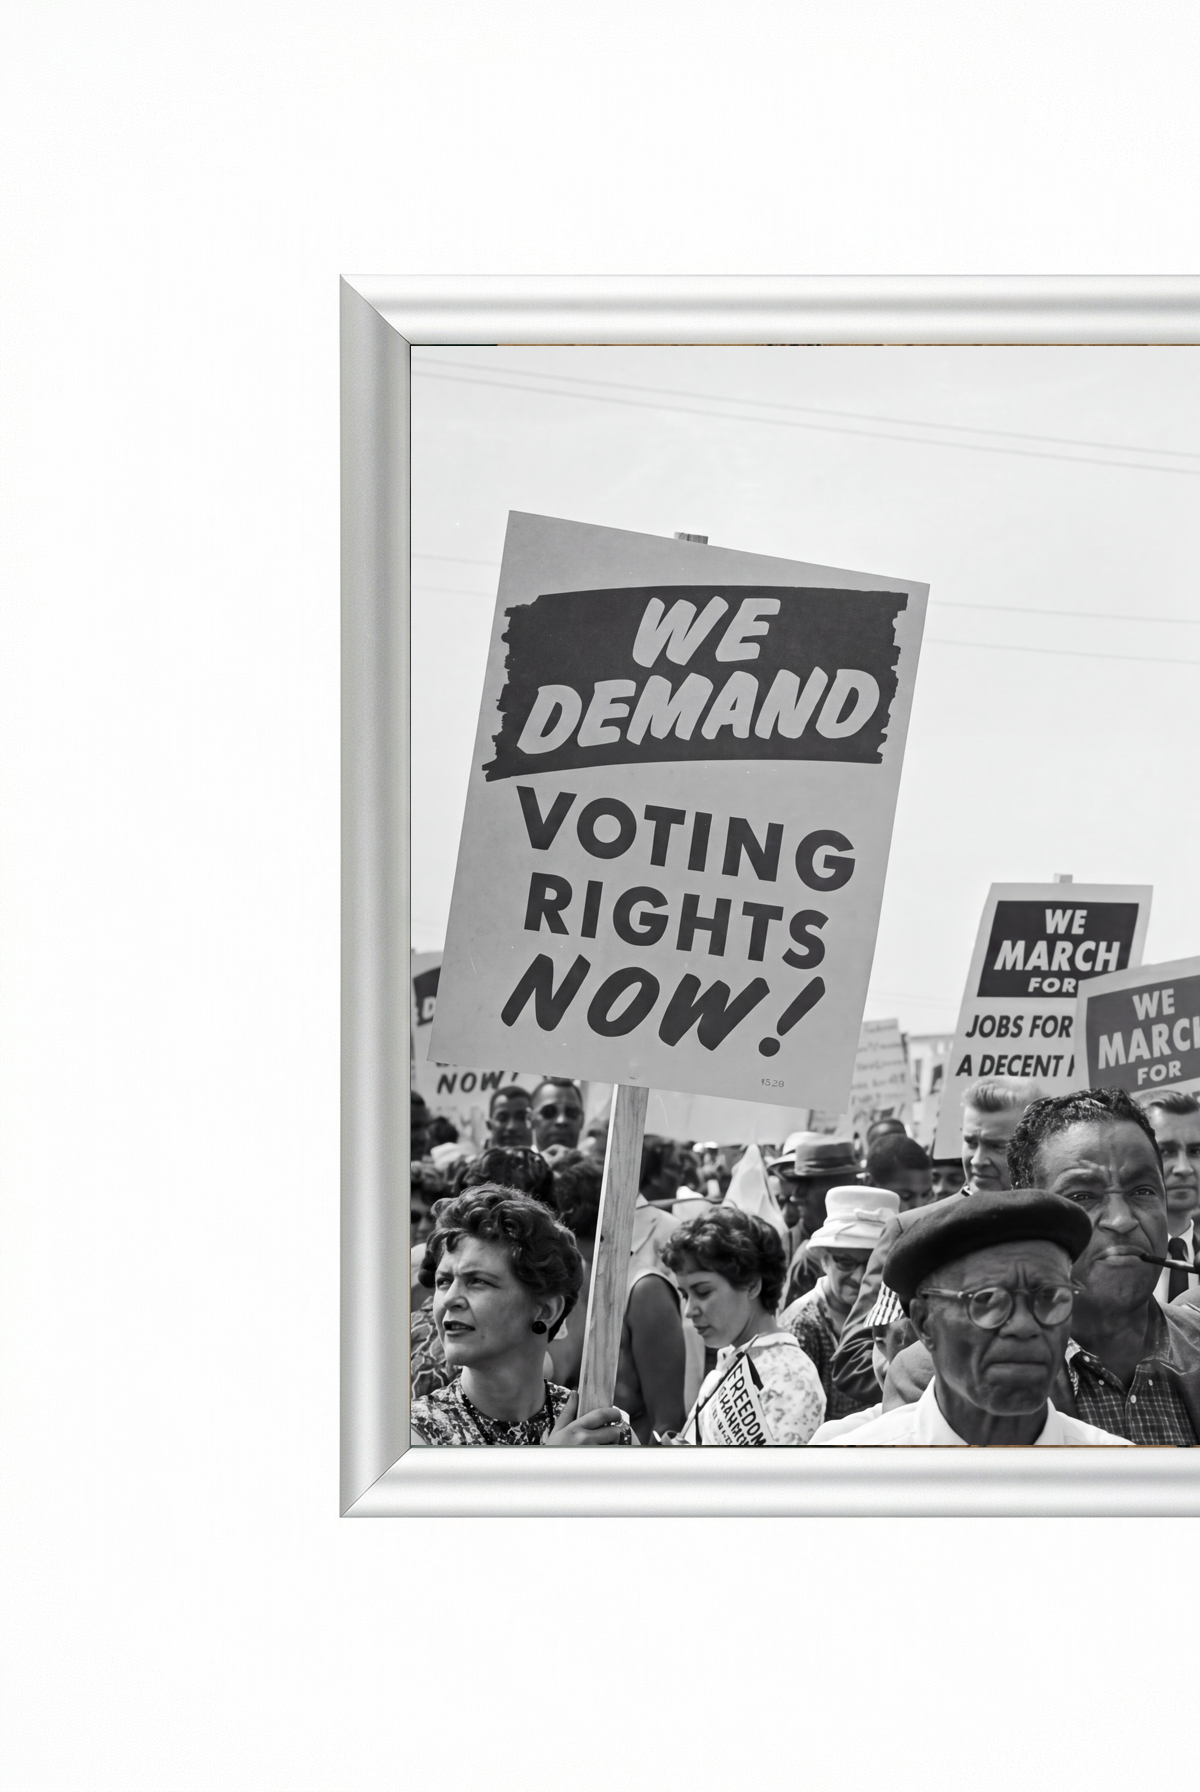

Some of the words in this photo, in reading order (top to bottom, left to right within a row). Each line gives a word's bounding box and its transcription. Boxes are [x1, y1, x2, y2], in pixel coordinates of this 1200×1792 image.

[632, 596, 781, 668] WE
[516, 666, 881, 755] DEMAND
[516, 785, 856, 892] VOTING
[524, 872, 829, 970] RIGHTS
[1045, 909, 1088, 935] WE
[994, 940, 1121, 972] MARCH
[1028, 977, 1077, 993] FOR
[500, 954, 826, 1057] NOW!
[1132, 988, 1175, 1021] WE
[965, 1015, 1025, 1038] JOBS
[1029, 1015, 1074, 1038] FOR
[955, 1054, 972, 1077] A
[978, 1054, 1064, 1077] DECENT
[1138, 1060, 1182, 1085] FOR
[727, 1363, 767, 1446] FREEDOM
